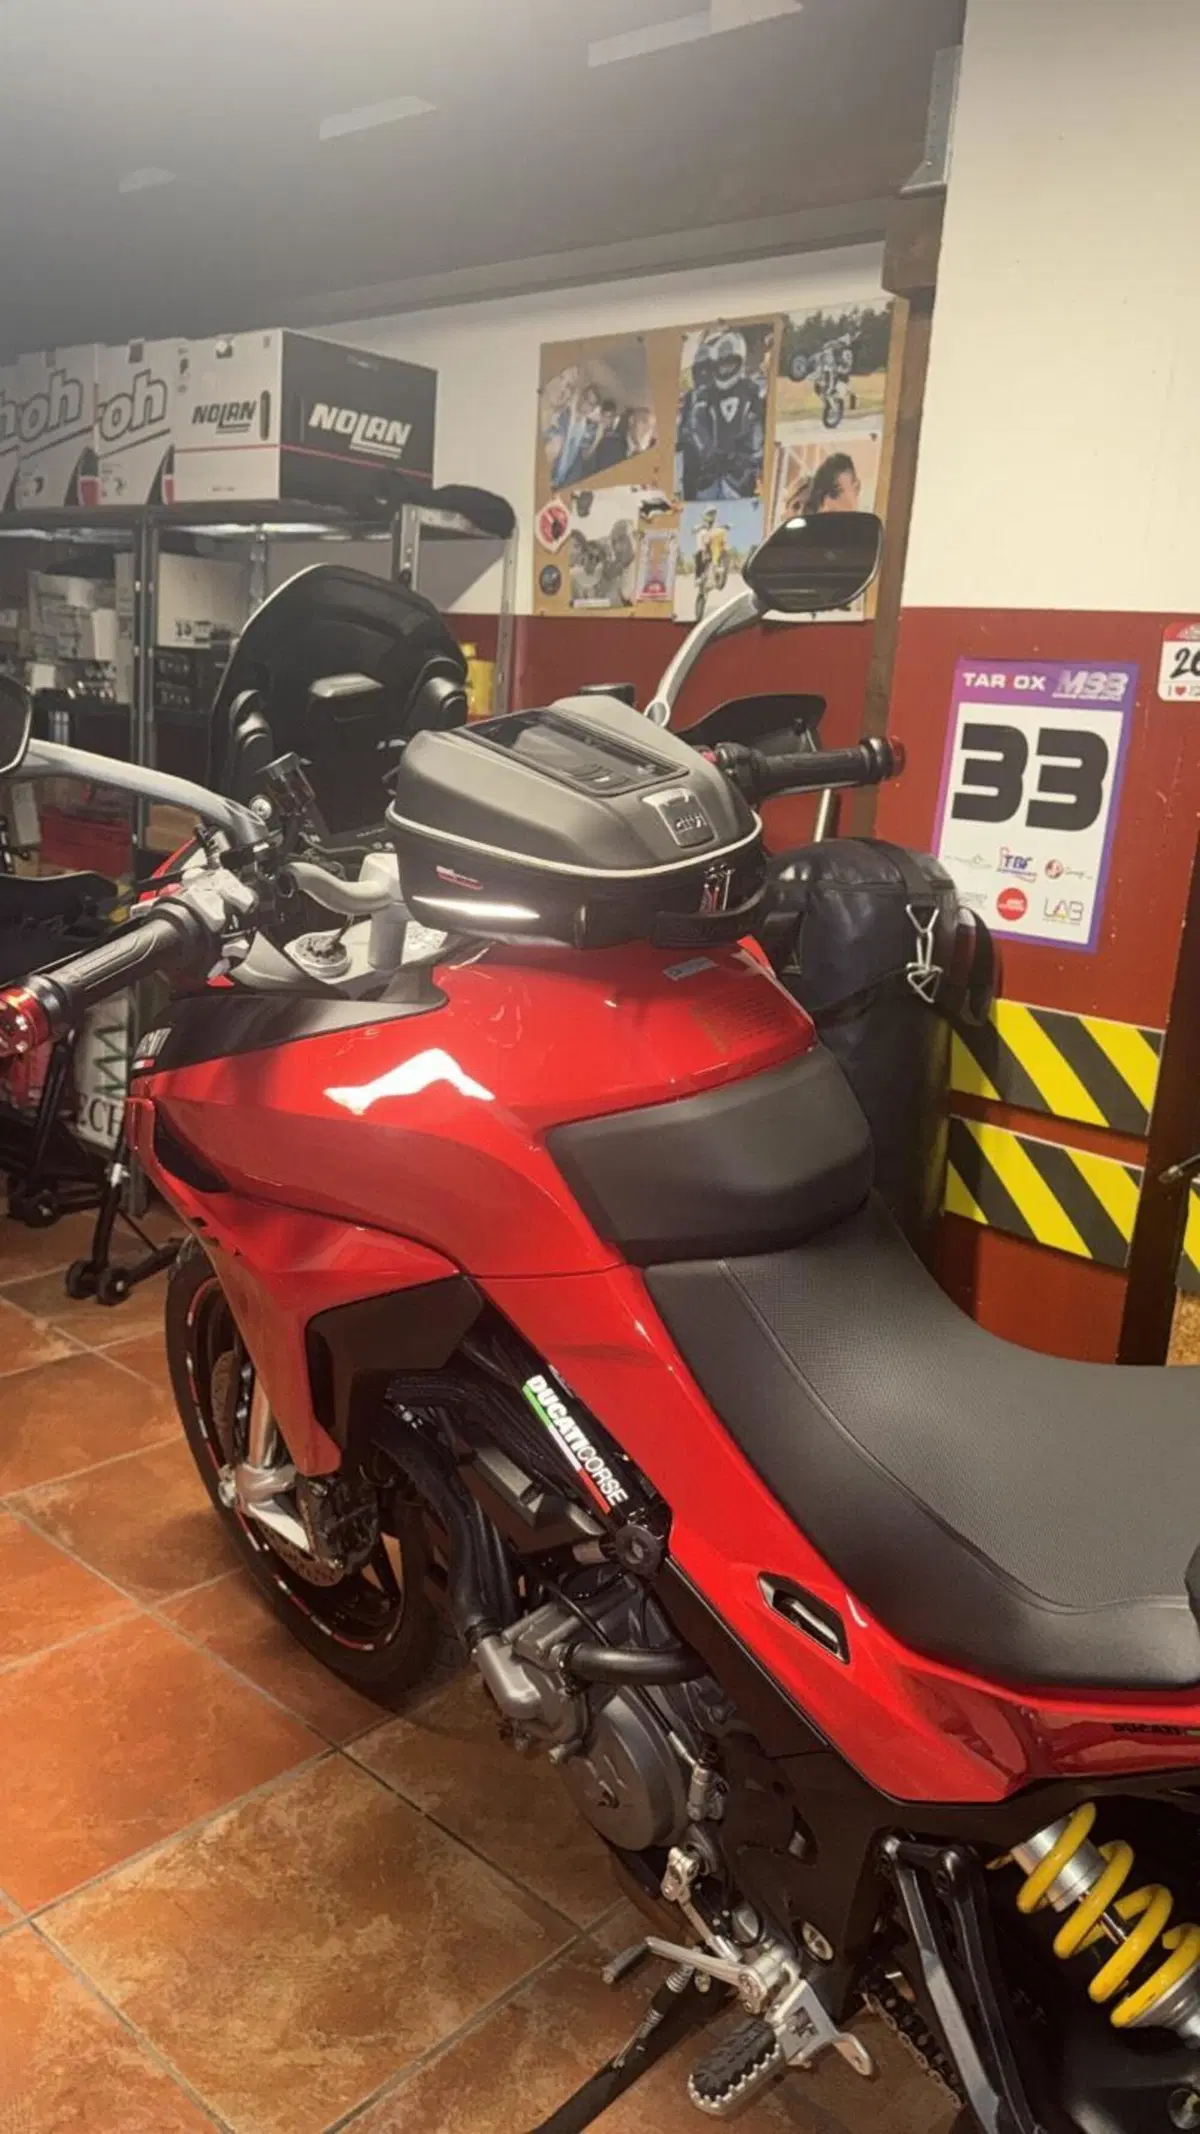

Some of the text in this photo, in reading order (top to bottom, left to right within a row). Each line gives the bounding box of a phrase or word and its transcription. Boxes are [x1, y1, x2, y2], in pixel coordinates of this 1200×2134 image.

[192, 401, 257, 430] NOLAN
[308, 403, 412, 454] NOLAN
[963, 671, 1047, 691] TAR OX
[951, 722, 1109, 832] 33
